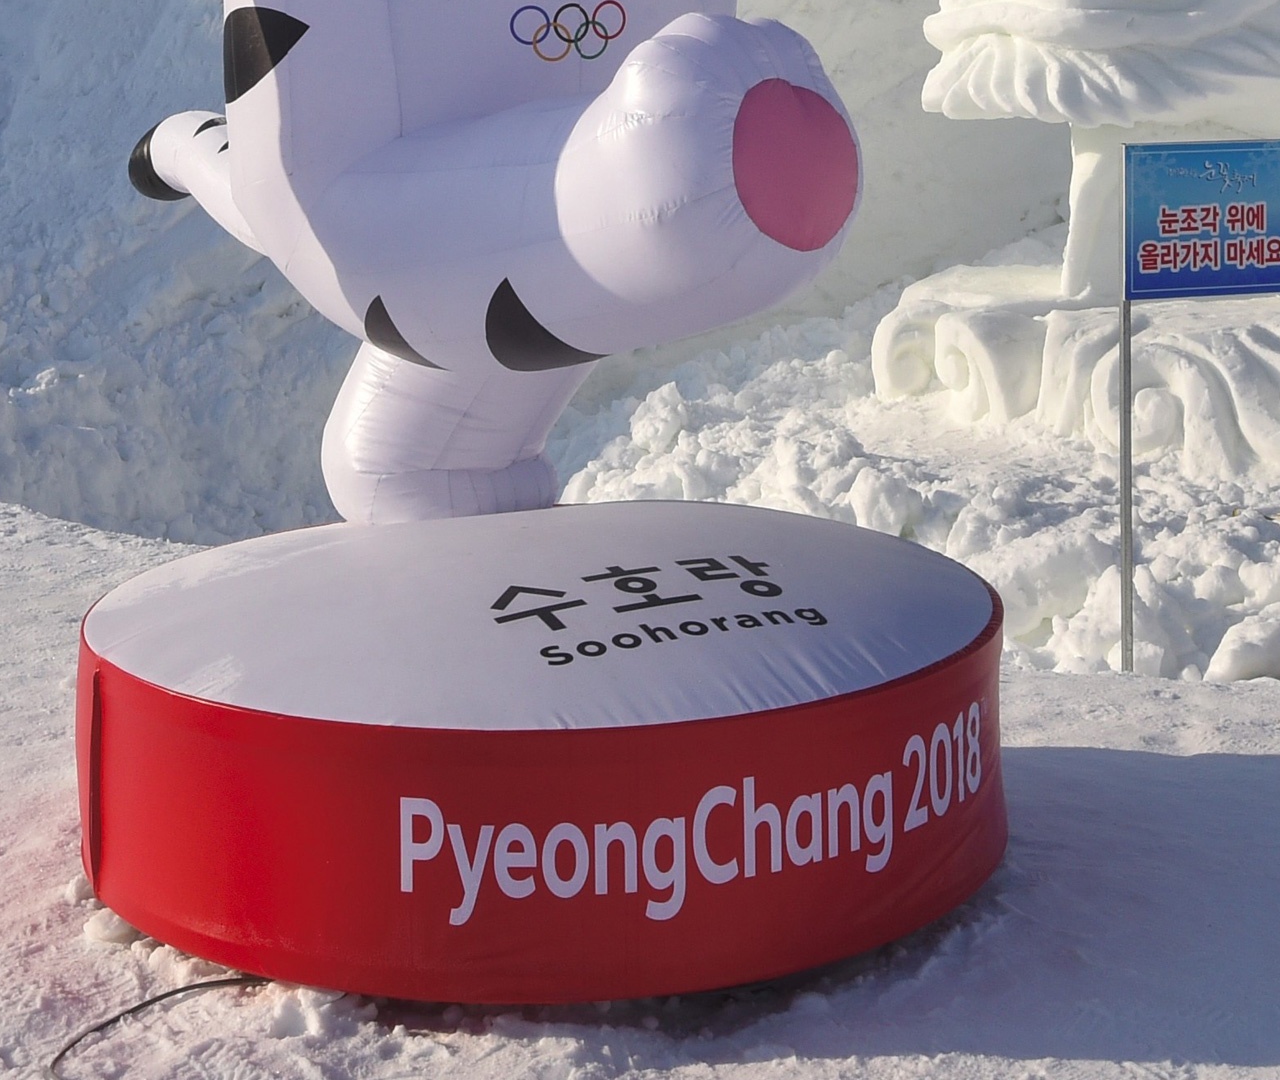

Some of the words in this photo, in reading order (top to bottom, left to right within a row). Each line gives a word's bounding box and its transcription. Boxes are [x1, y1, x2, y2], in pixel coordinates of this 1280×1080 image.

[1159, 205, 1220, 235] 눈조각
[1226, 203, 1265, 232] 위에
[1140, 239, 1219, 271] 올라가지
[490, 554, 786, 632] 수호랑
[539, 604, 828, 666] Soohorang
[400, 771, 892, 926] PyeongChang
[904, 701, 983, 832] 2018
